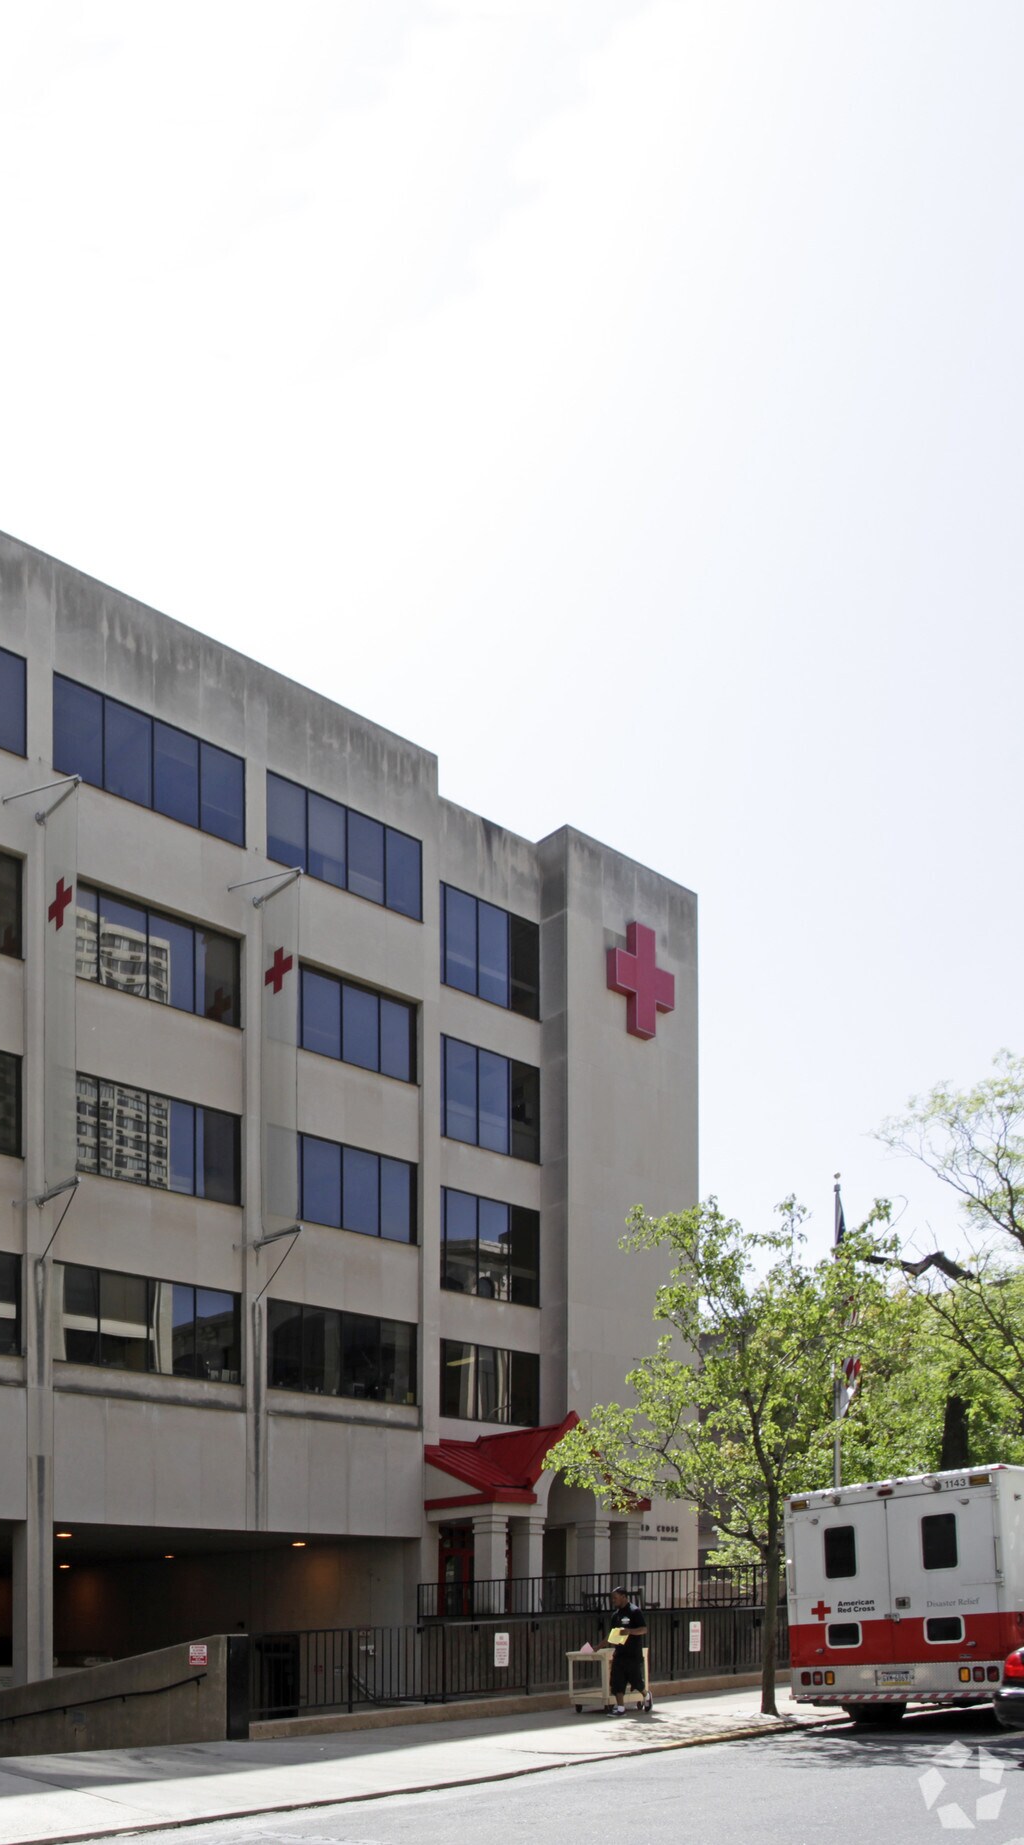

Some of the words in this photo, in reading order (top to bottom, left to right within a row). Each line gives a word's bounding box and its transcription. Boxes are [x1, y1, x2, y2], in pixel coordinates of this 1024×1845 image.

[945, 1479, 966, 1488] 1143
[656, 1525, 679, 1533] CROSS
[926, 1600, 956, 1608] Disaster
[957, 1597, 979, 1606] Relief
